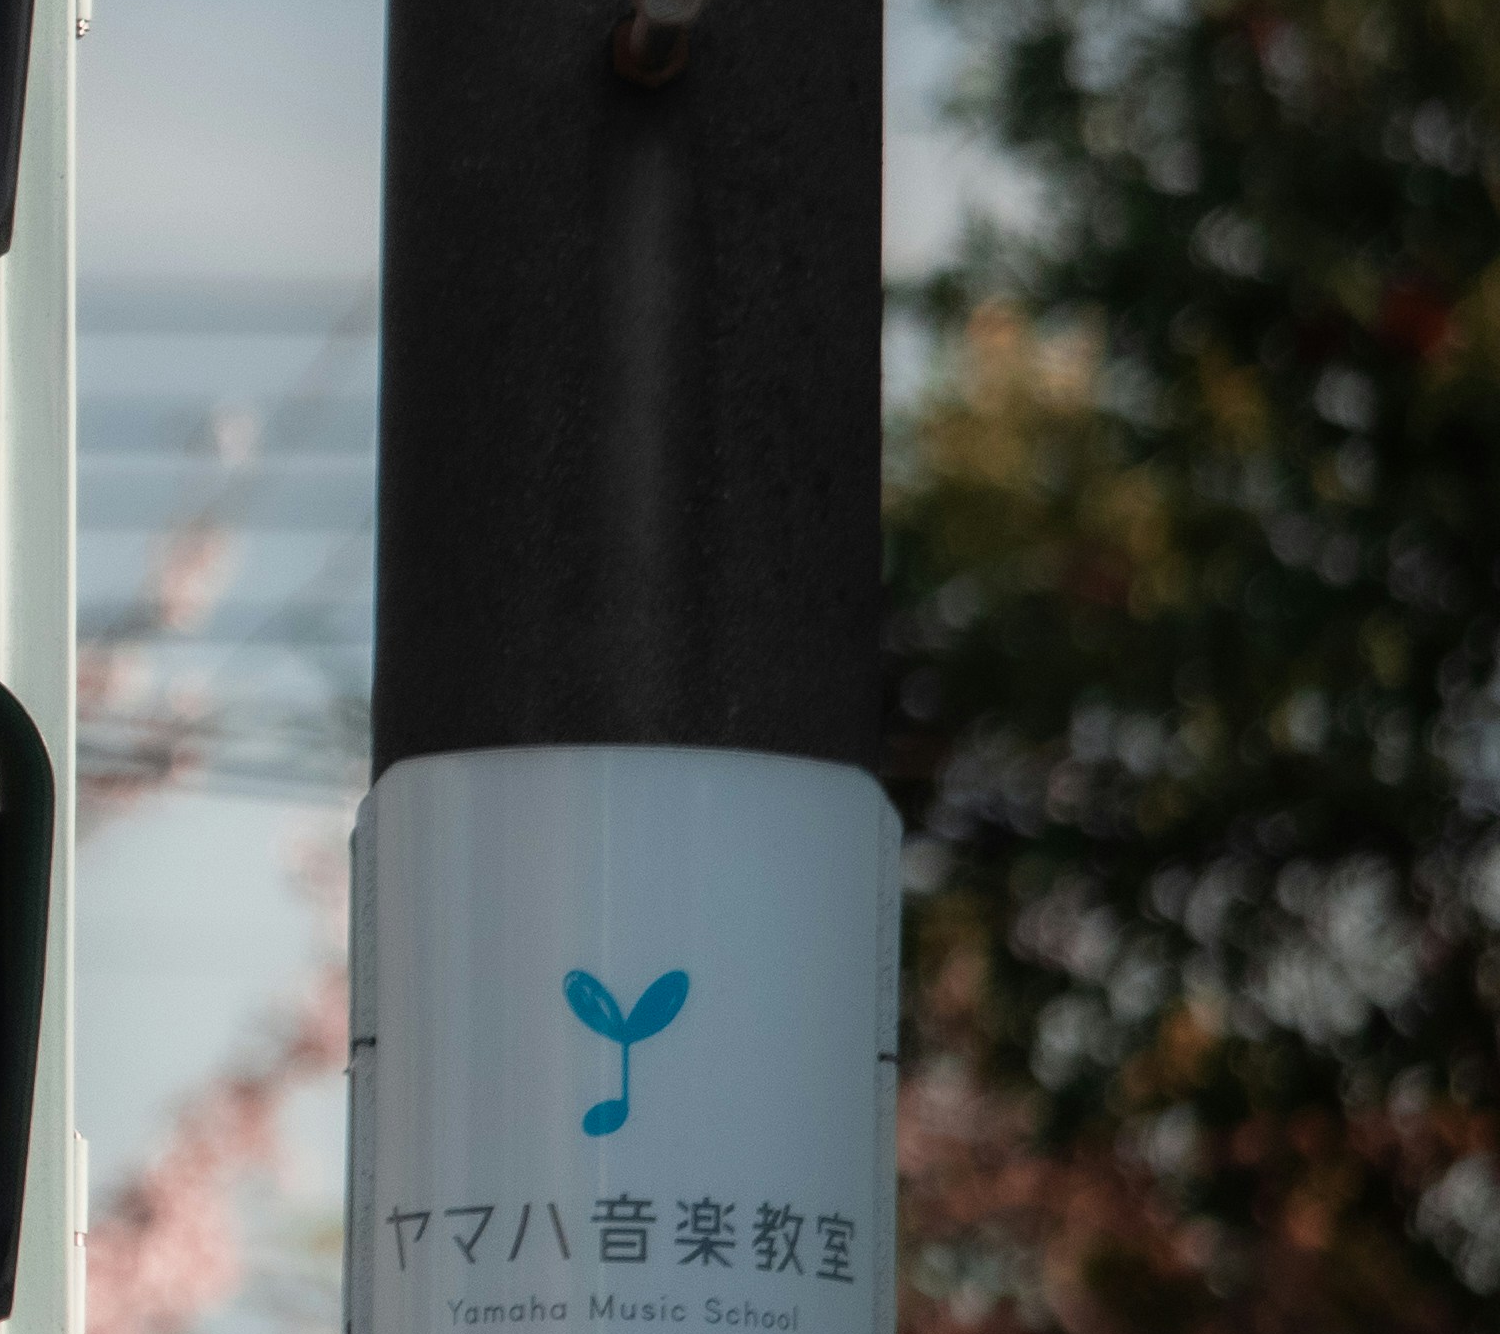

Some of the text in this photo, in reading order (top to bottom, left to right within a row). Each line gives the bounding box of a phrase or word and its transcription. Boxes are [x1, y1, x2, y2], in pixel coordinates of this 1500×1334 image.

[385, 1191, 856, 1285] ヤマハ音楽教室
[447, 1292, 799, 1332] Yamaha Music School
